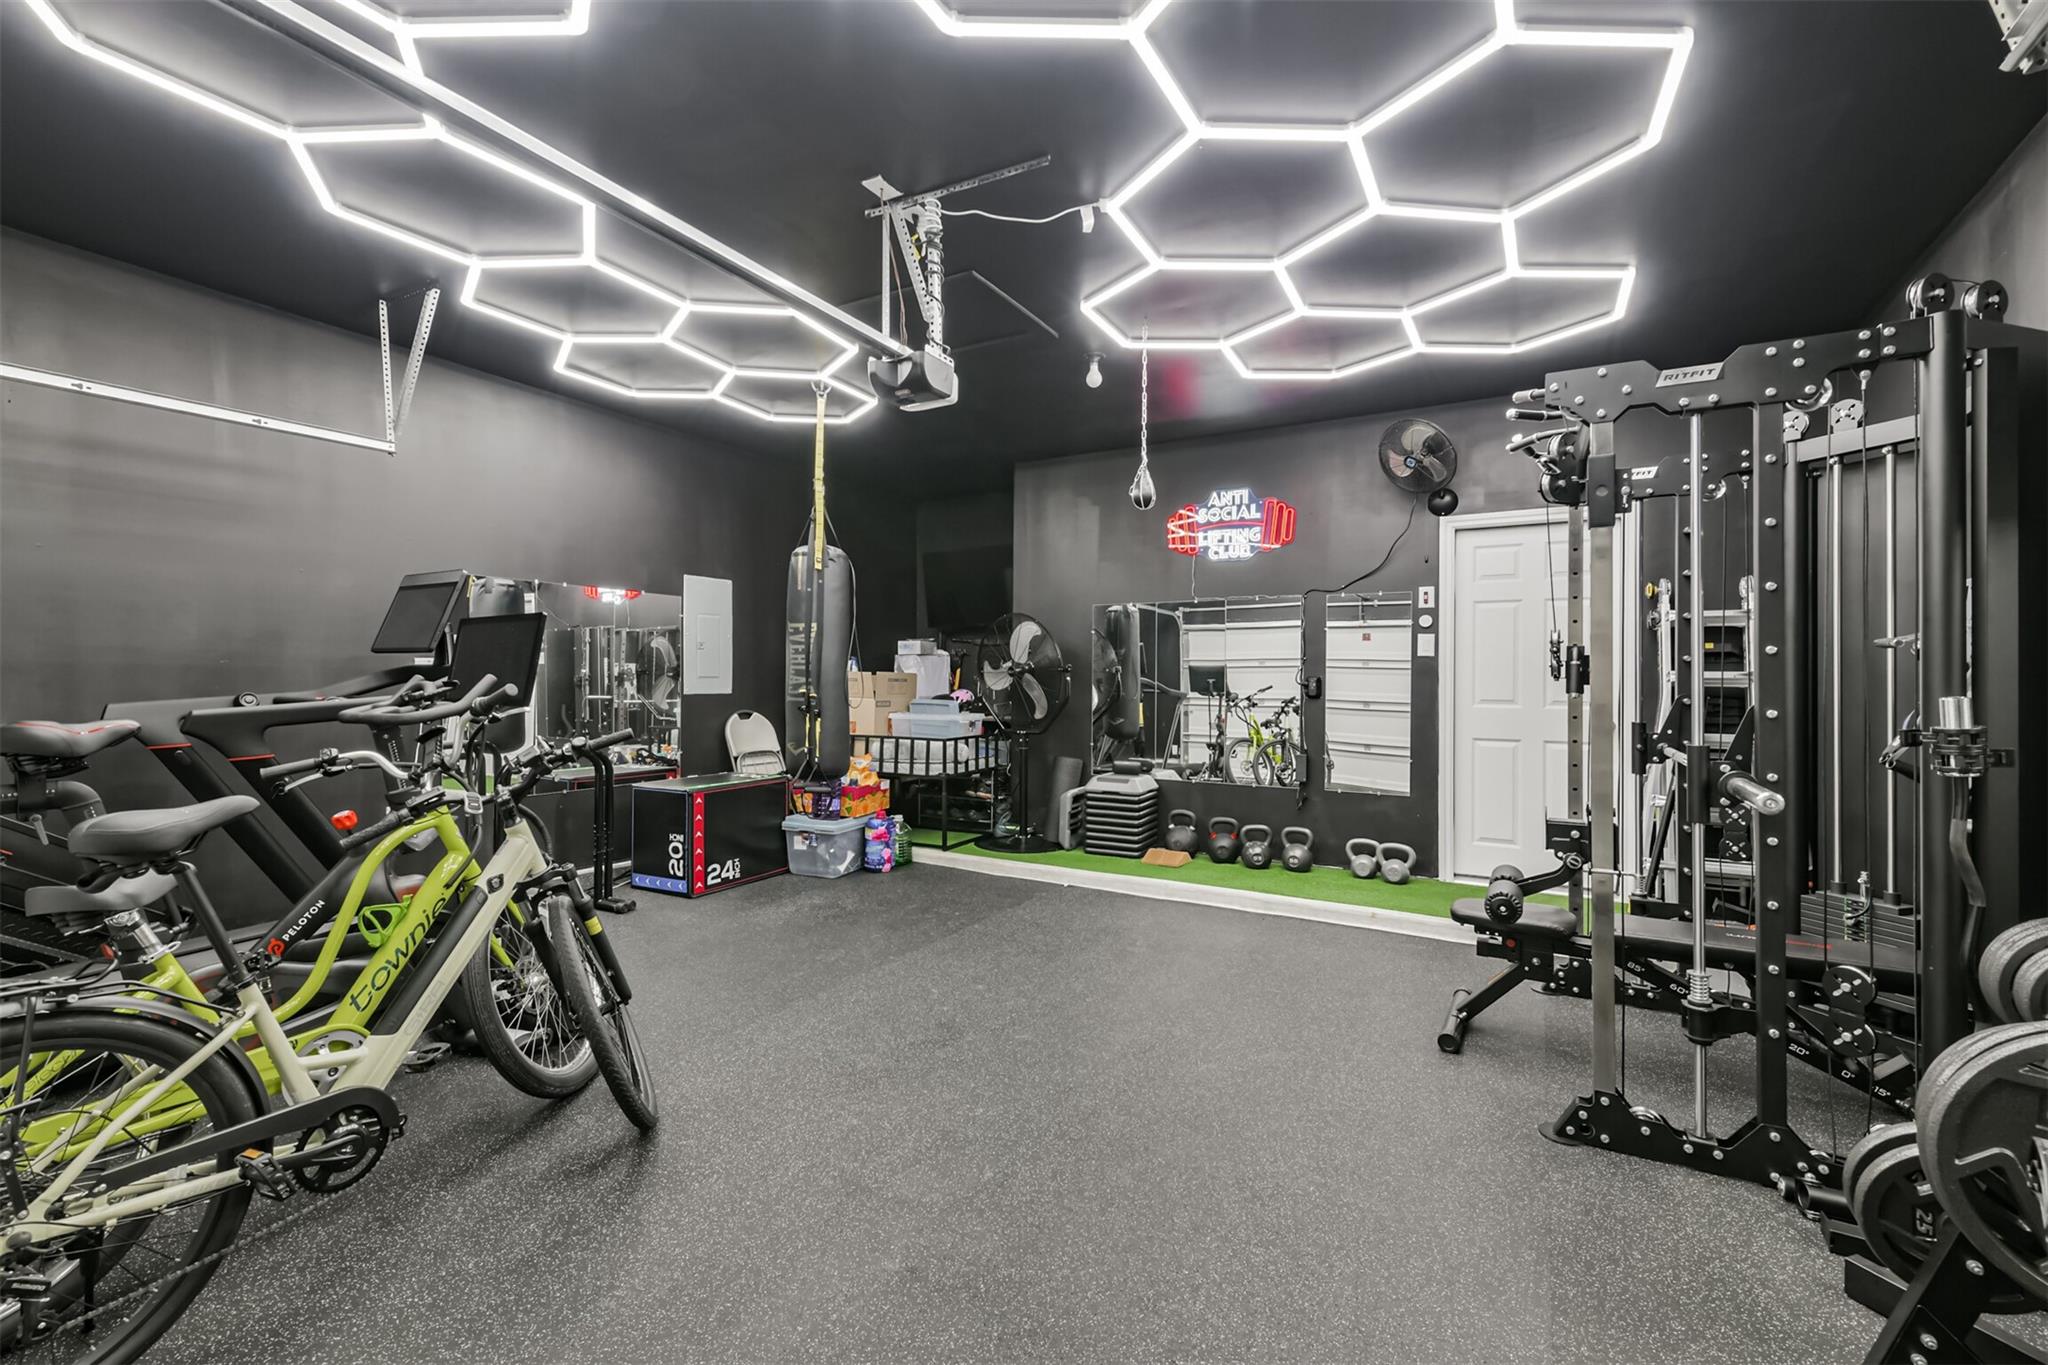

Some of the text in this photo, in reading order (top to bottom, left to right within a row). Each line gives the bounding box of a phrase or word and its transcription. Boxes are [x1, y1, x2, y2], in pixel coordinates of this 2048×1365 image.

[1663, 367, 1716, 381] RITFIT
[1207, 489, 1249, 507] ANTI
[1197, 503, 1261, 523] SOCIAL
[1198, 527, 1261, 546] LIFTING
[1208, 544, 1251, 560] CLUB
[668, 841, 684, 877] 20
[706, 860, 734, 886] 24
[282, 899, 326, 942] PELOTON
[350, 896, 446, 1013] townie
[1915, 1208, 1934, 1236] 25
